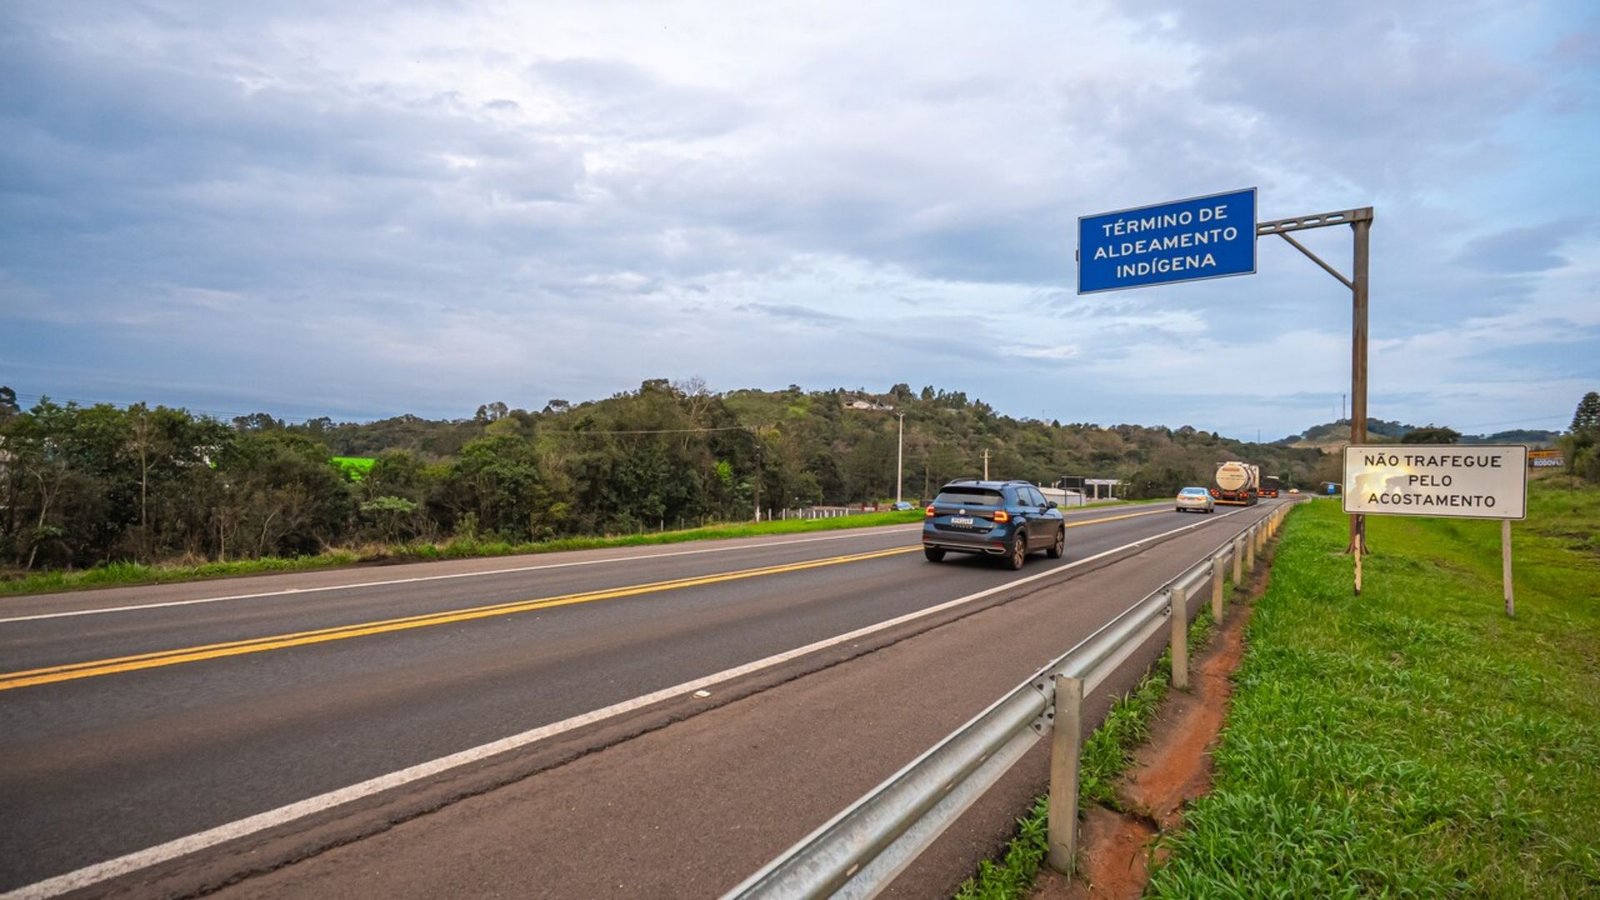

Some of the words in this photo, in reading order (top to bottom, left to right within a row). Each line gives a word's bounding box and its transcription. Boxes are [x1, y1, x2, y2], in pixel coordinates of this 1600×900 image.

[1102, 211, 1192, 237] TÉRMINO
[1200, 205, 1228, 223] DE
[1094, 227, 1237, 260] ALDEAMENTO
[1116, 253, 1217, 278] INDÍGENA
[1364, 452, 1399, 467] NÃO
[1404, 455, 1502, 468] TRAFEGUE
[1409, 475, 1452, 487] PELO
[1368, 493, 1496, 508] ACOSTAMENTO
